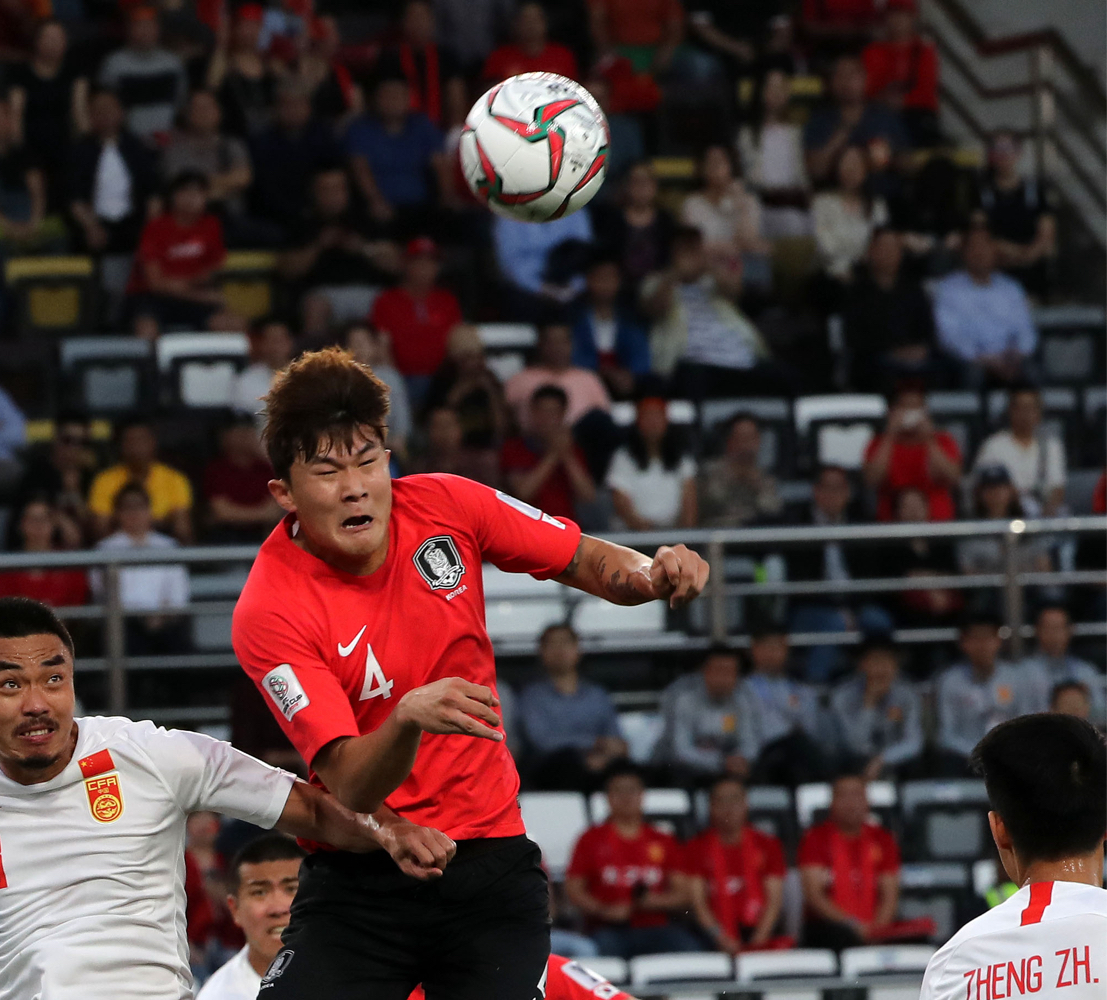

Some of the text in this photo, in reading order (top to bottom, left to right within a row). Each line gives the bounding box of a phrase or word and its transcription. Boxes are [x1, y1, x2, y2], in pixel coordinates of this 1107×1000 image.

[445, 584, 468, 601] KOREA
[359, 643, 394, 701] 4
[87, 777, 117, 791] CFA
[1055, 945, 1099, 988] ZH.
